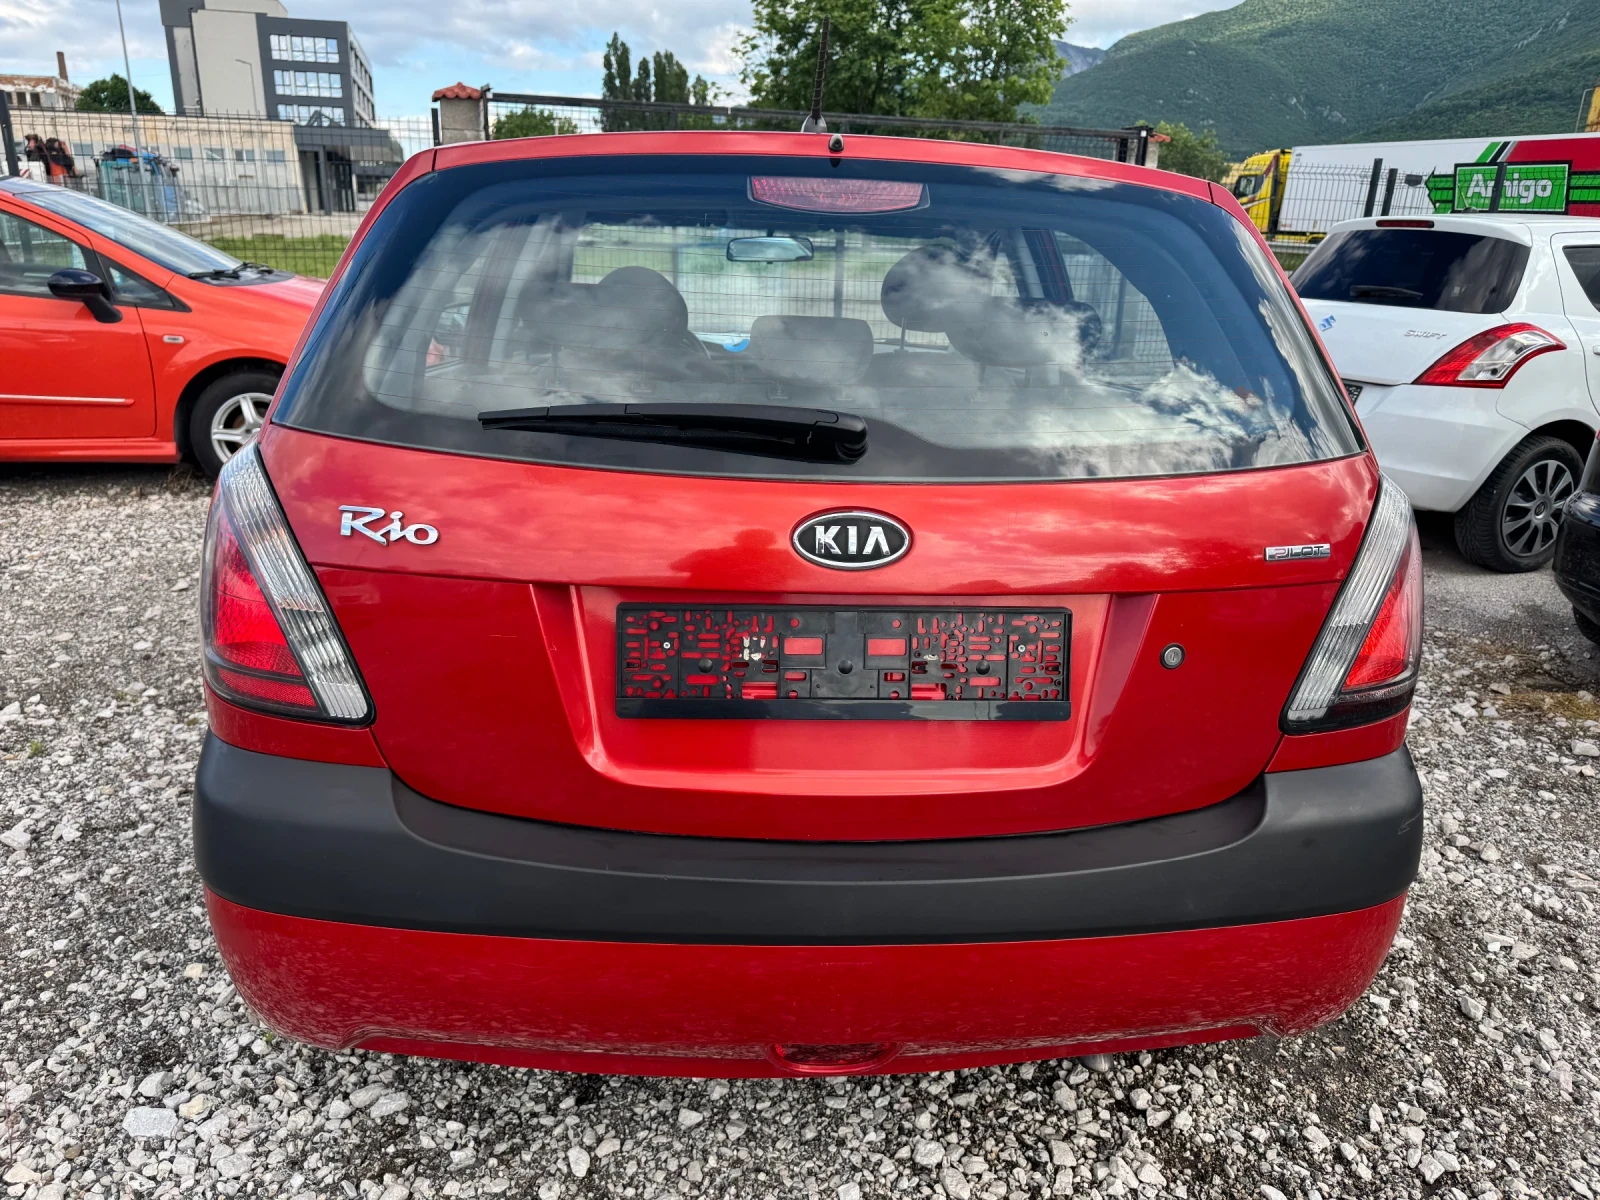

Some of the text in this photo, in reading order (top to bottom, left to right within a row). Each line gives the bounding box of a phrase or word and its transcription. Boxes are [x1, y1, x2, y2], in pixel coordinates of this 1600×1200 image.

[1466, 172, 1553, 204] Amigo
[1404, 329, 1448, 340] SWIFT
[338, 504, 440, 547] Rio
[814, 525, 891, 556] KIA
[1274, 545, 1324, 559] PILOT
